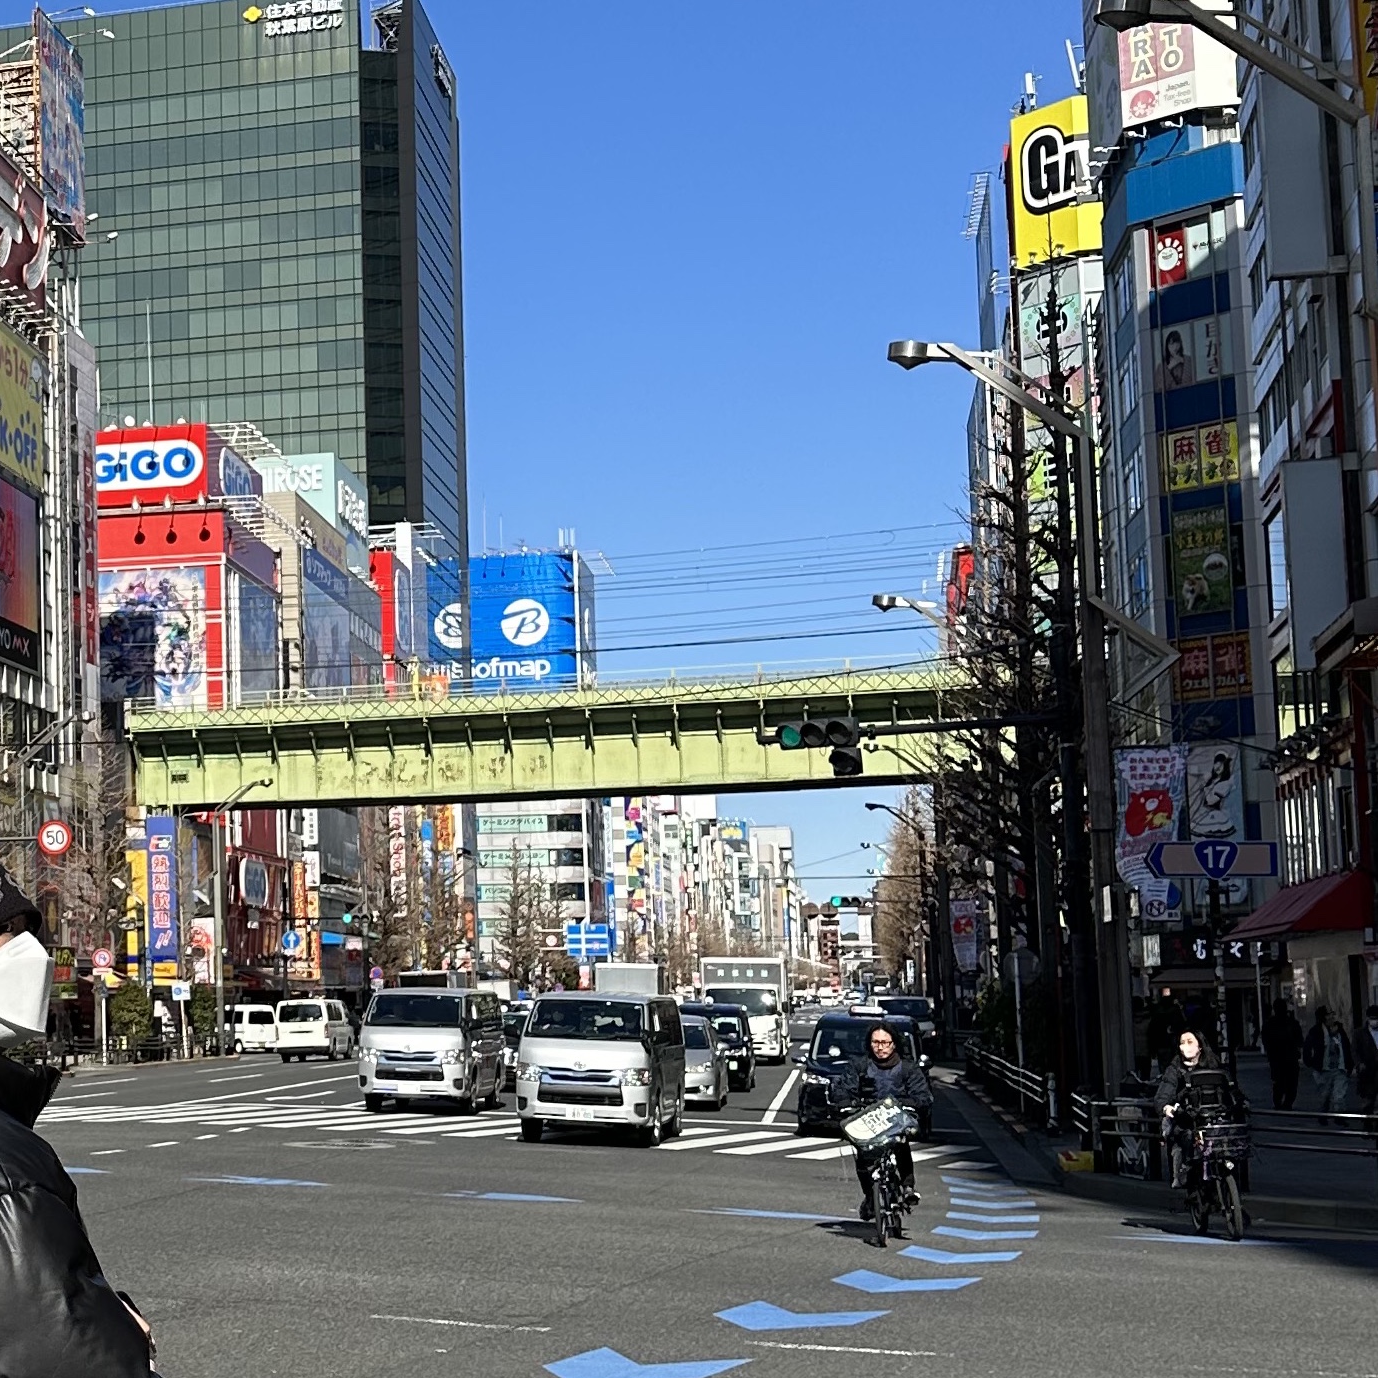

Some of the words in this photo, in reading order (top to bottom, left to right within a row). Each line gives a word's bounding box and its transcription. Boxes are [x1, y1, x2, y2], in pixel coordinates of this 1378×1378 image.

[265, 14, 342, 37] 秋葉原ビル
[12, 635, 31, 660] MX
[471, 657, 550, 680] ofmap
[46, 831, 65, 846] 50
[1203, 845, 1231, 869] 17
